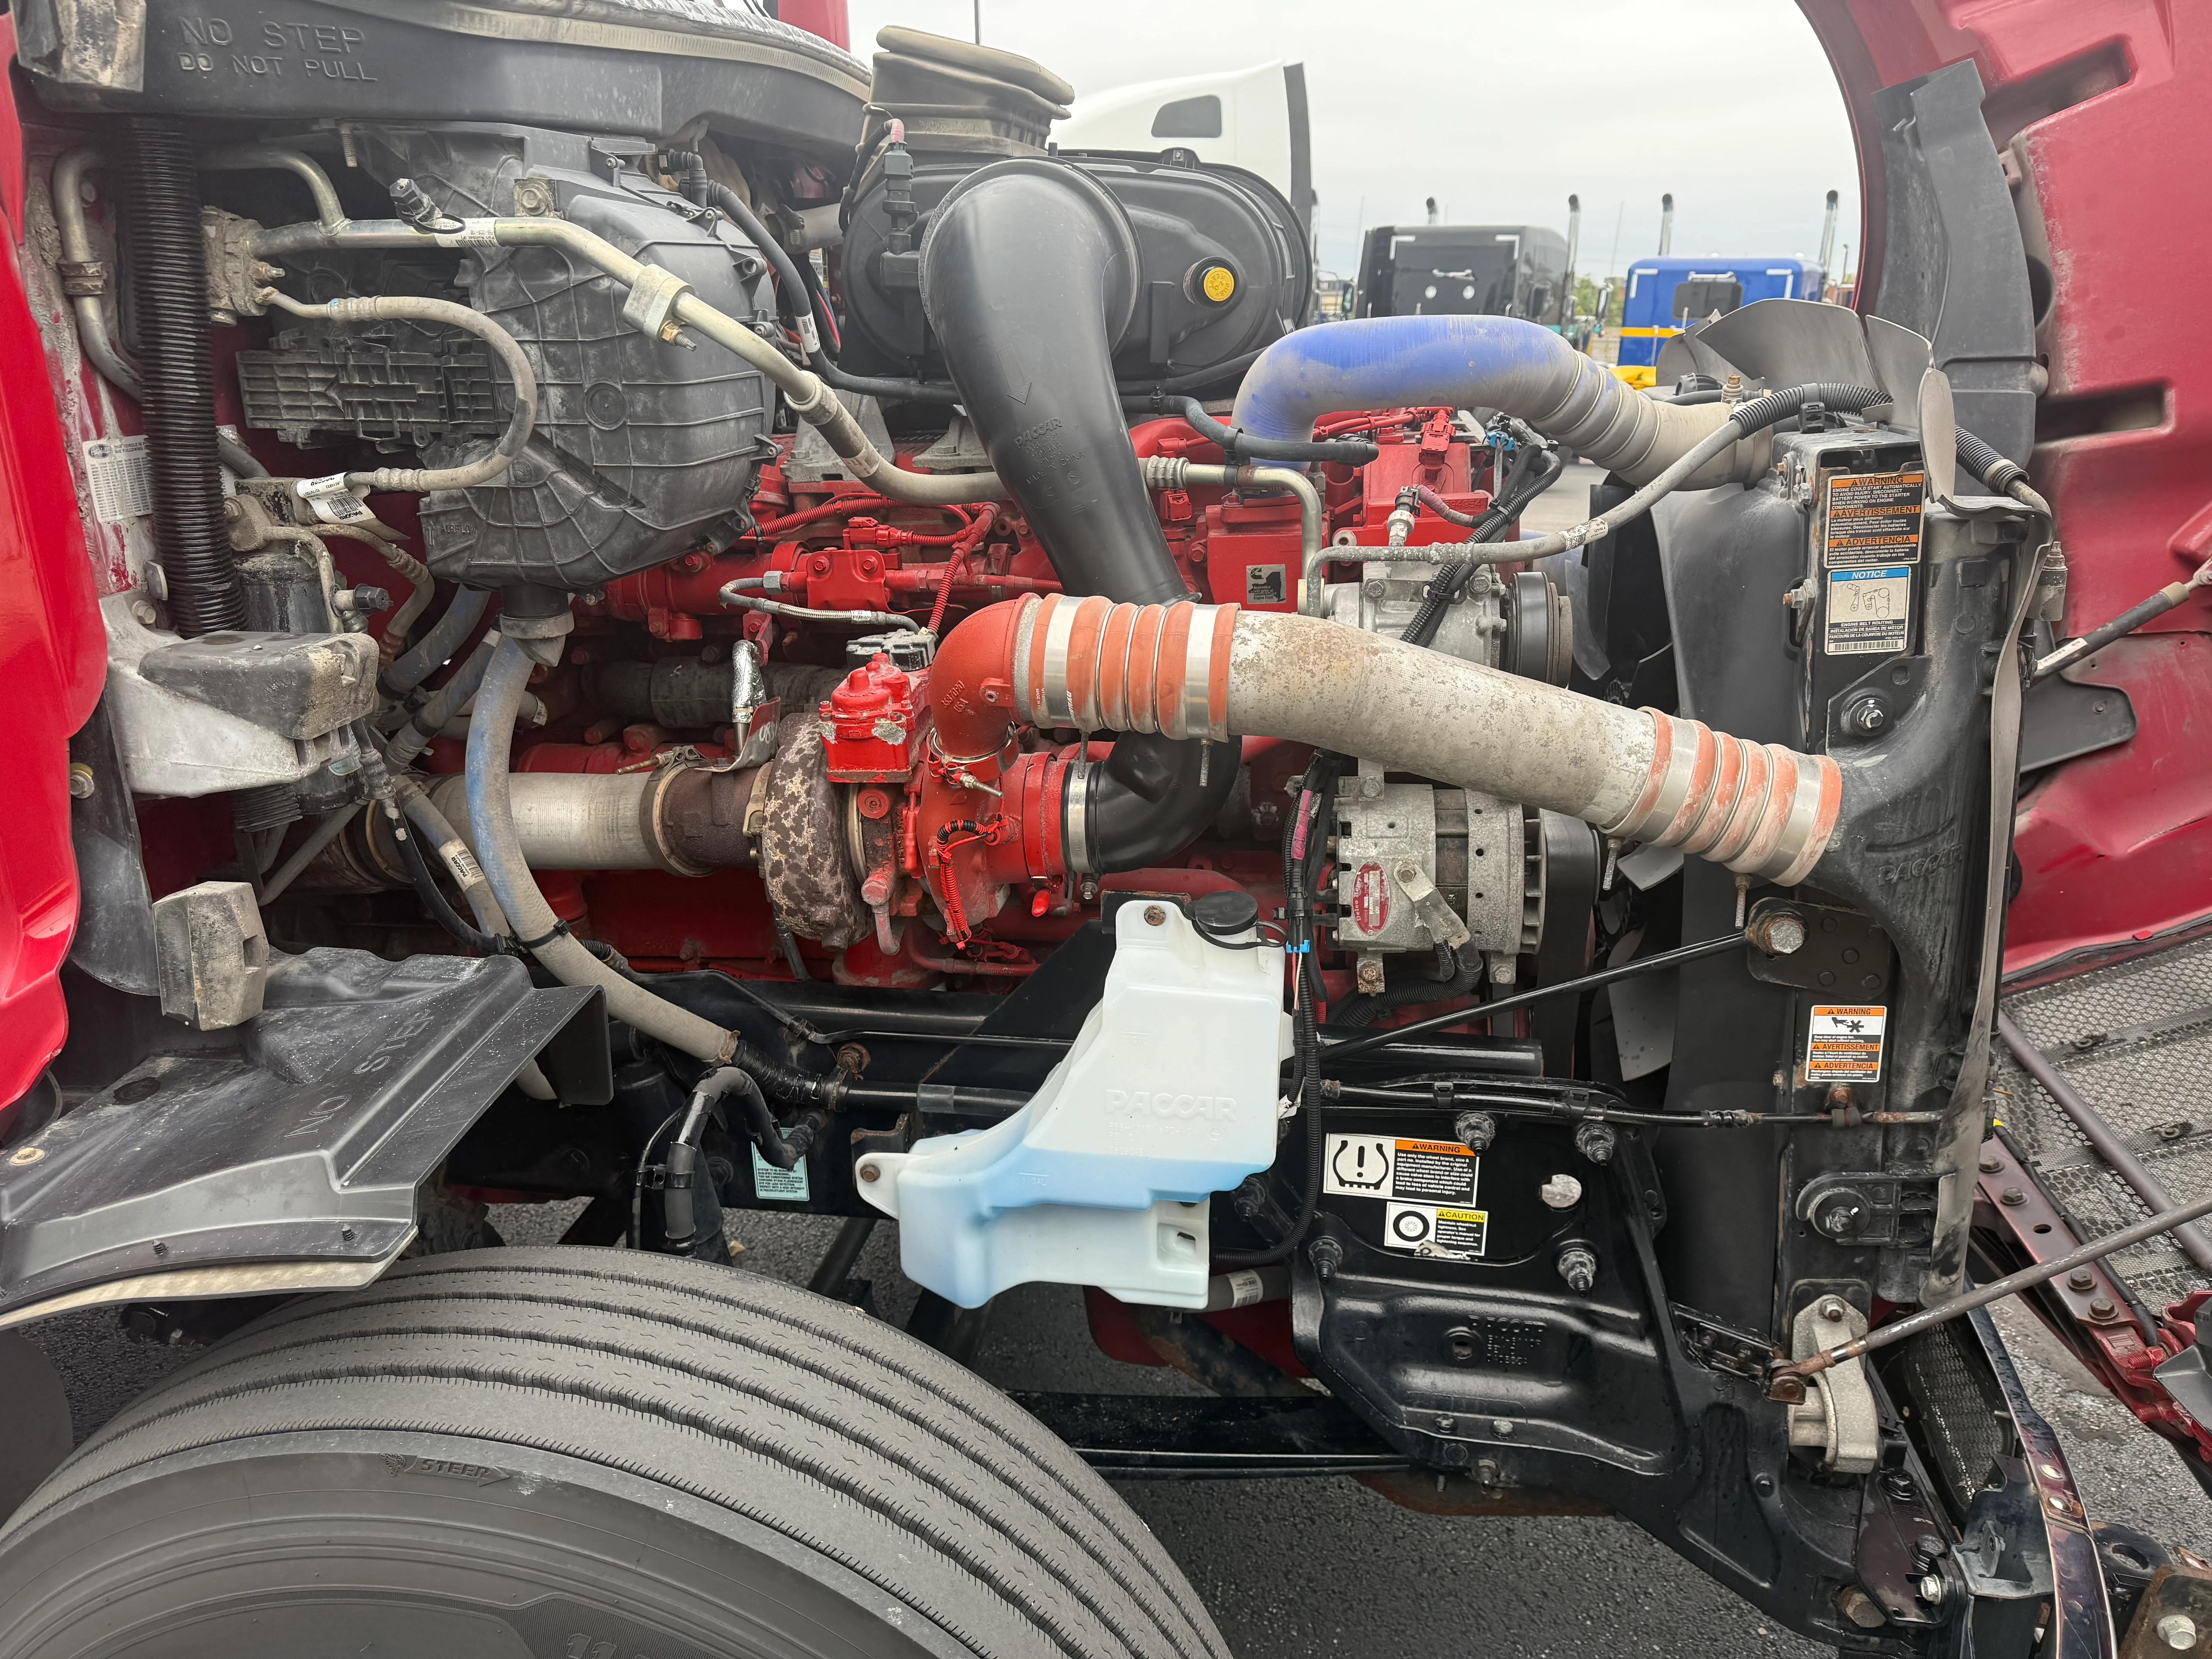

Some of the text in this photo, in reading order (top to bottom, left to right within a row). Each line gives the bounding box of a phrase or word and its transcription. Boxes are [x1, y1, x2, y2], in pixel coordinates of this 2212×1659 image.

[178, 16, 364, 53] NO STEP
[177, 52, 377, 81] DO NOT PULL
[1209, 273, 1225, 289] RESET
[1014, 417, 1062, 449] PACCAR
[1027, 469, 1046, 484] MADE
[1061, 451, 1085, 465] CHINA
[1859, 477, 1903, 485] WARNING
[1841, 506, 1918, 517] AVERTISSEMENT
[442, 524, 477, 533] AIRFLOW
[1846, 536, 1910, 545] ADVERTENCIA
[1852, 570, 1887, 579] NOTICE
[953, 698, 969, 713] USA
[452, 856, 467, 877] PACCAR
[1878, 844, 1963, 886] PACCAR
[352, 1010, 434, 1074] STEP
[1106, 1089, 1238, 1121] PACCAR
[284, 1094, 352, 1139] NO
[1420, 1144, 1460, 1152] WARNING
[1032, 1178, 1046, 1186] GAL
[1446, 1212, 1484, 1220] CAUTION
[421, 1459, 491, 1479] STEER
